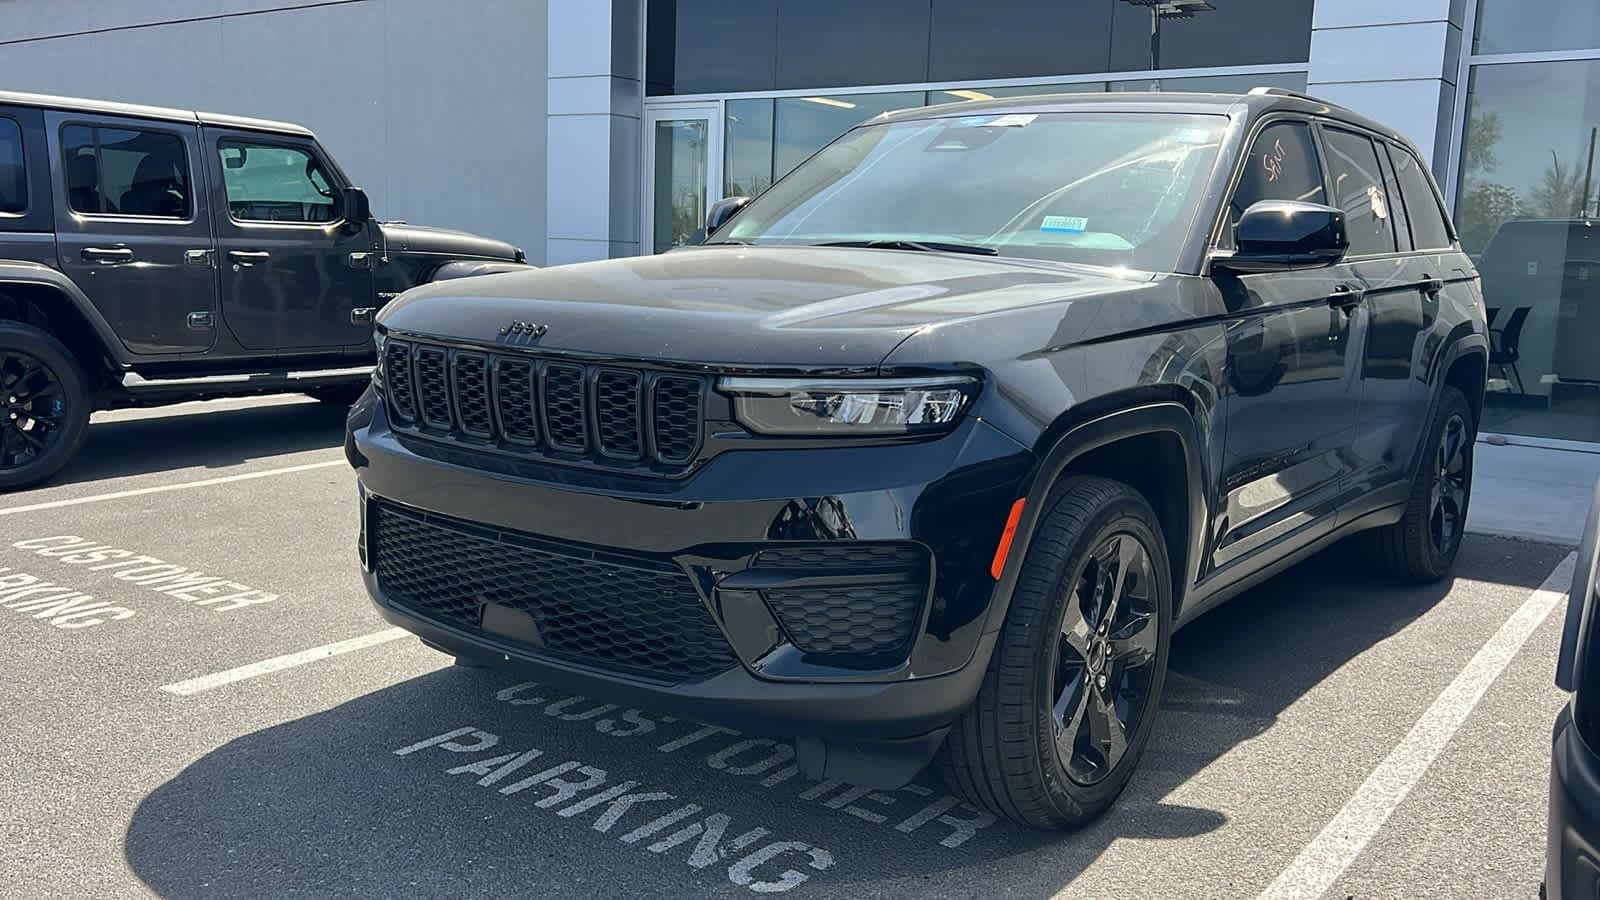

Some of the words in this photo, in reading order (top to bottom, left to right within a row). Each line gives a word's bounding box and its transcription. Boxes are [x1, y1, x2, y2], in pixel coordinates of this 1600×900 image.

[0, 567, 136, 628] RKING
[12, 535, 279, 612] CUSTOMER
[392, 726, 836, 893] PARKING
